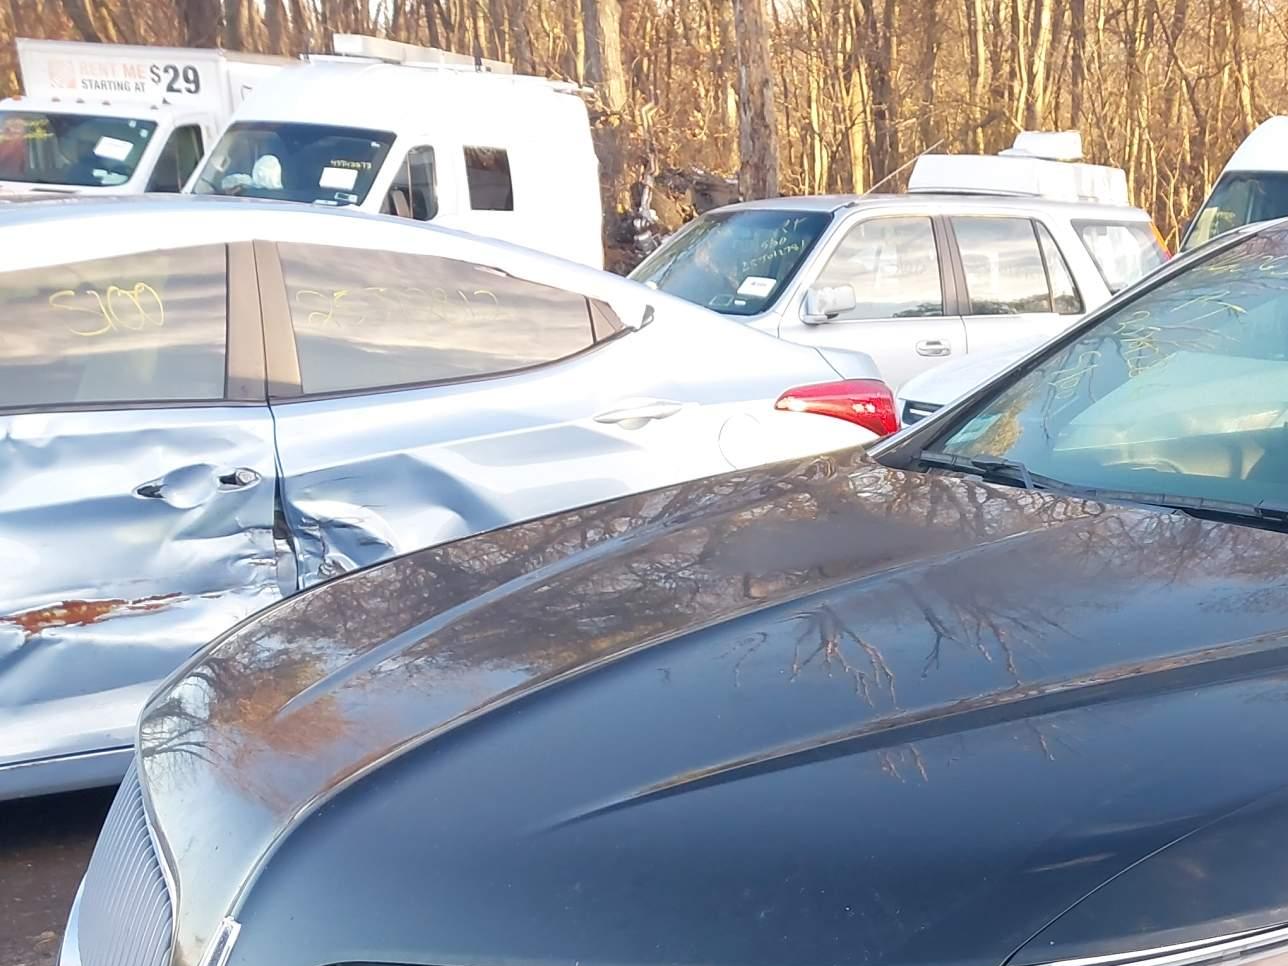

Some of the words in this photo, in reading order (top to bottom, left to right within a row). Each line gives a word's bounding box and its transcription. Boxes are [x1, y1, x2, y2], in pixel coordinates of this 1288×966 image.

[80, 61, 117, 78] RENT
[122, 63, 146, 80] ME
[150, 63, 201, 95] $29
[81, 78, 131, 92] STARTING
[134, 82, 145, 93] AT
